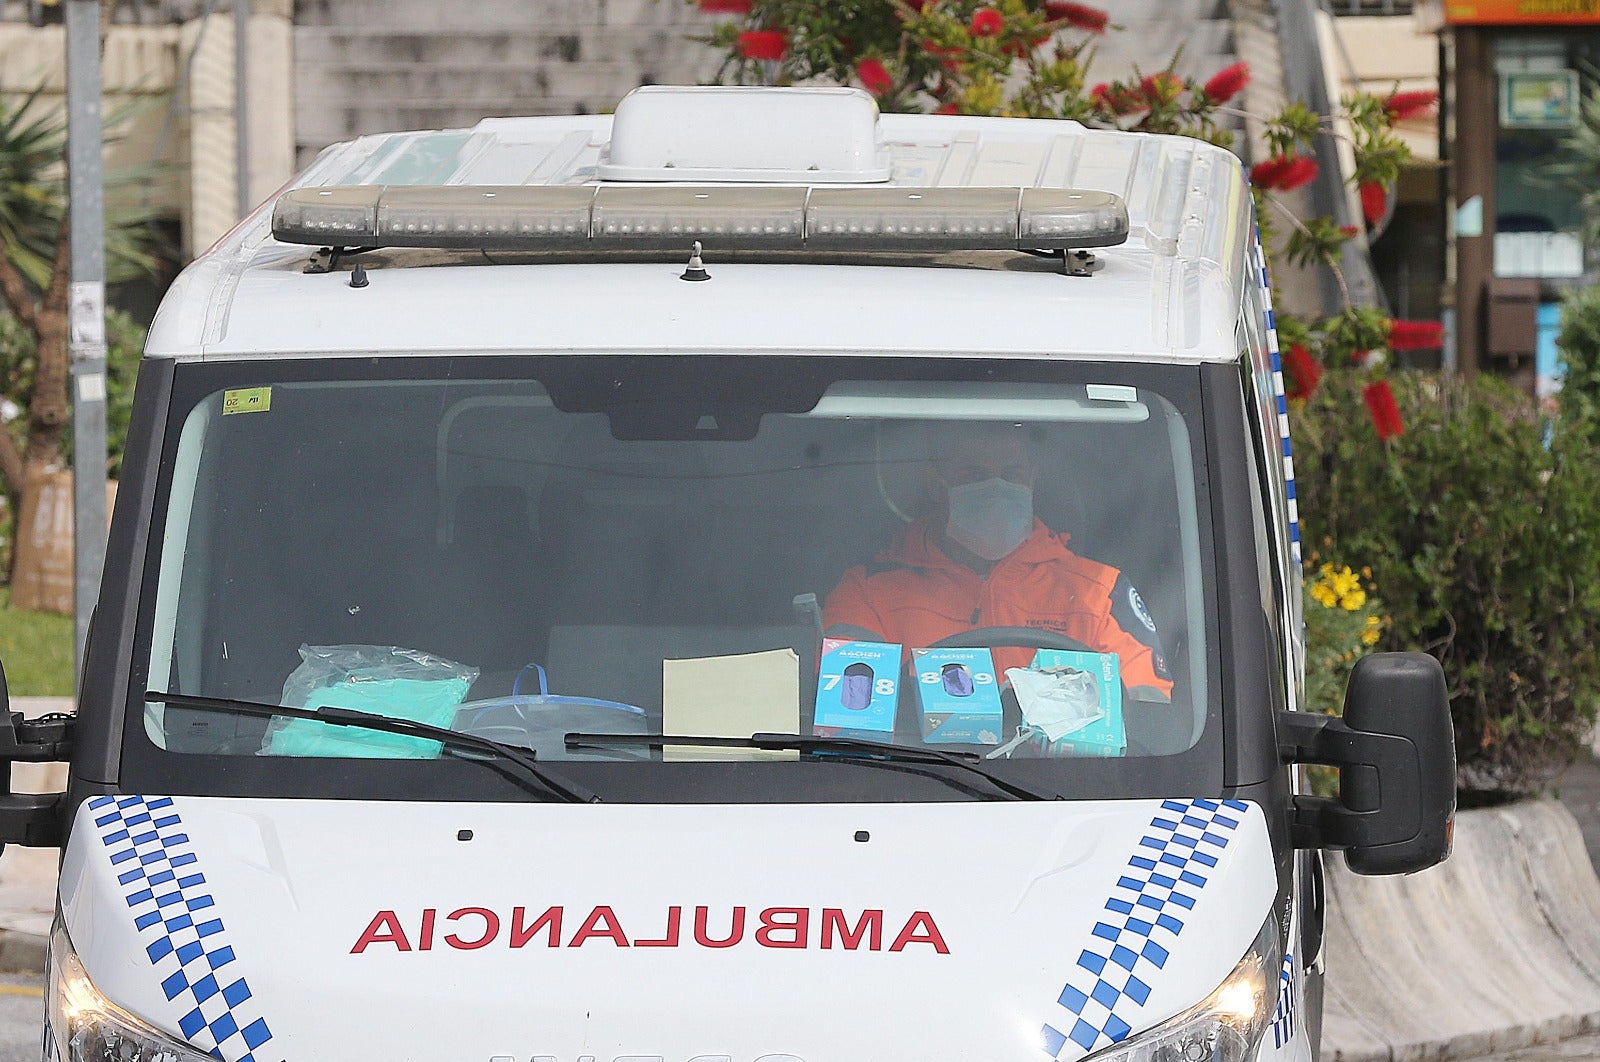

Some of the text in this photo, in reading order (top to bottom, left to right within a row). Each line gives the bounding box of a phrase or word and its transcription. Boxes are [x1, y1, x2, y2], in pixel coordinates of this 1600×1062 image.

[822, 674, 895, 695] 7 8
[921, 672, 993, 685] 8 9
